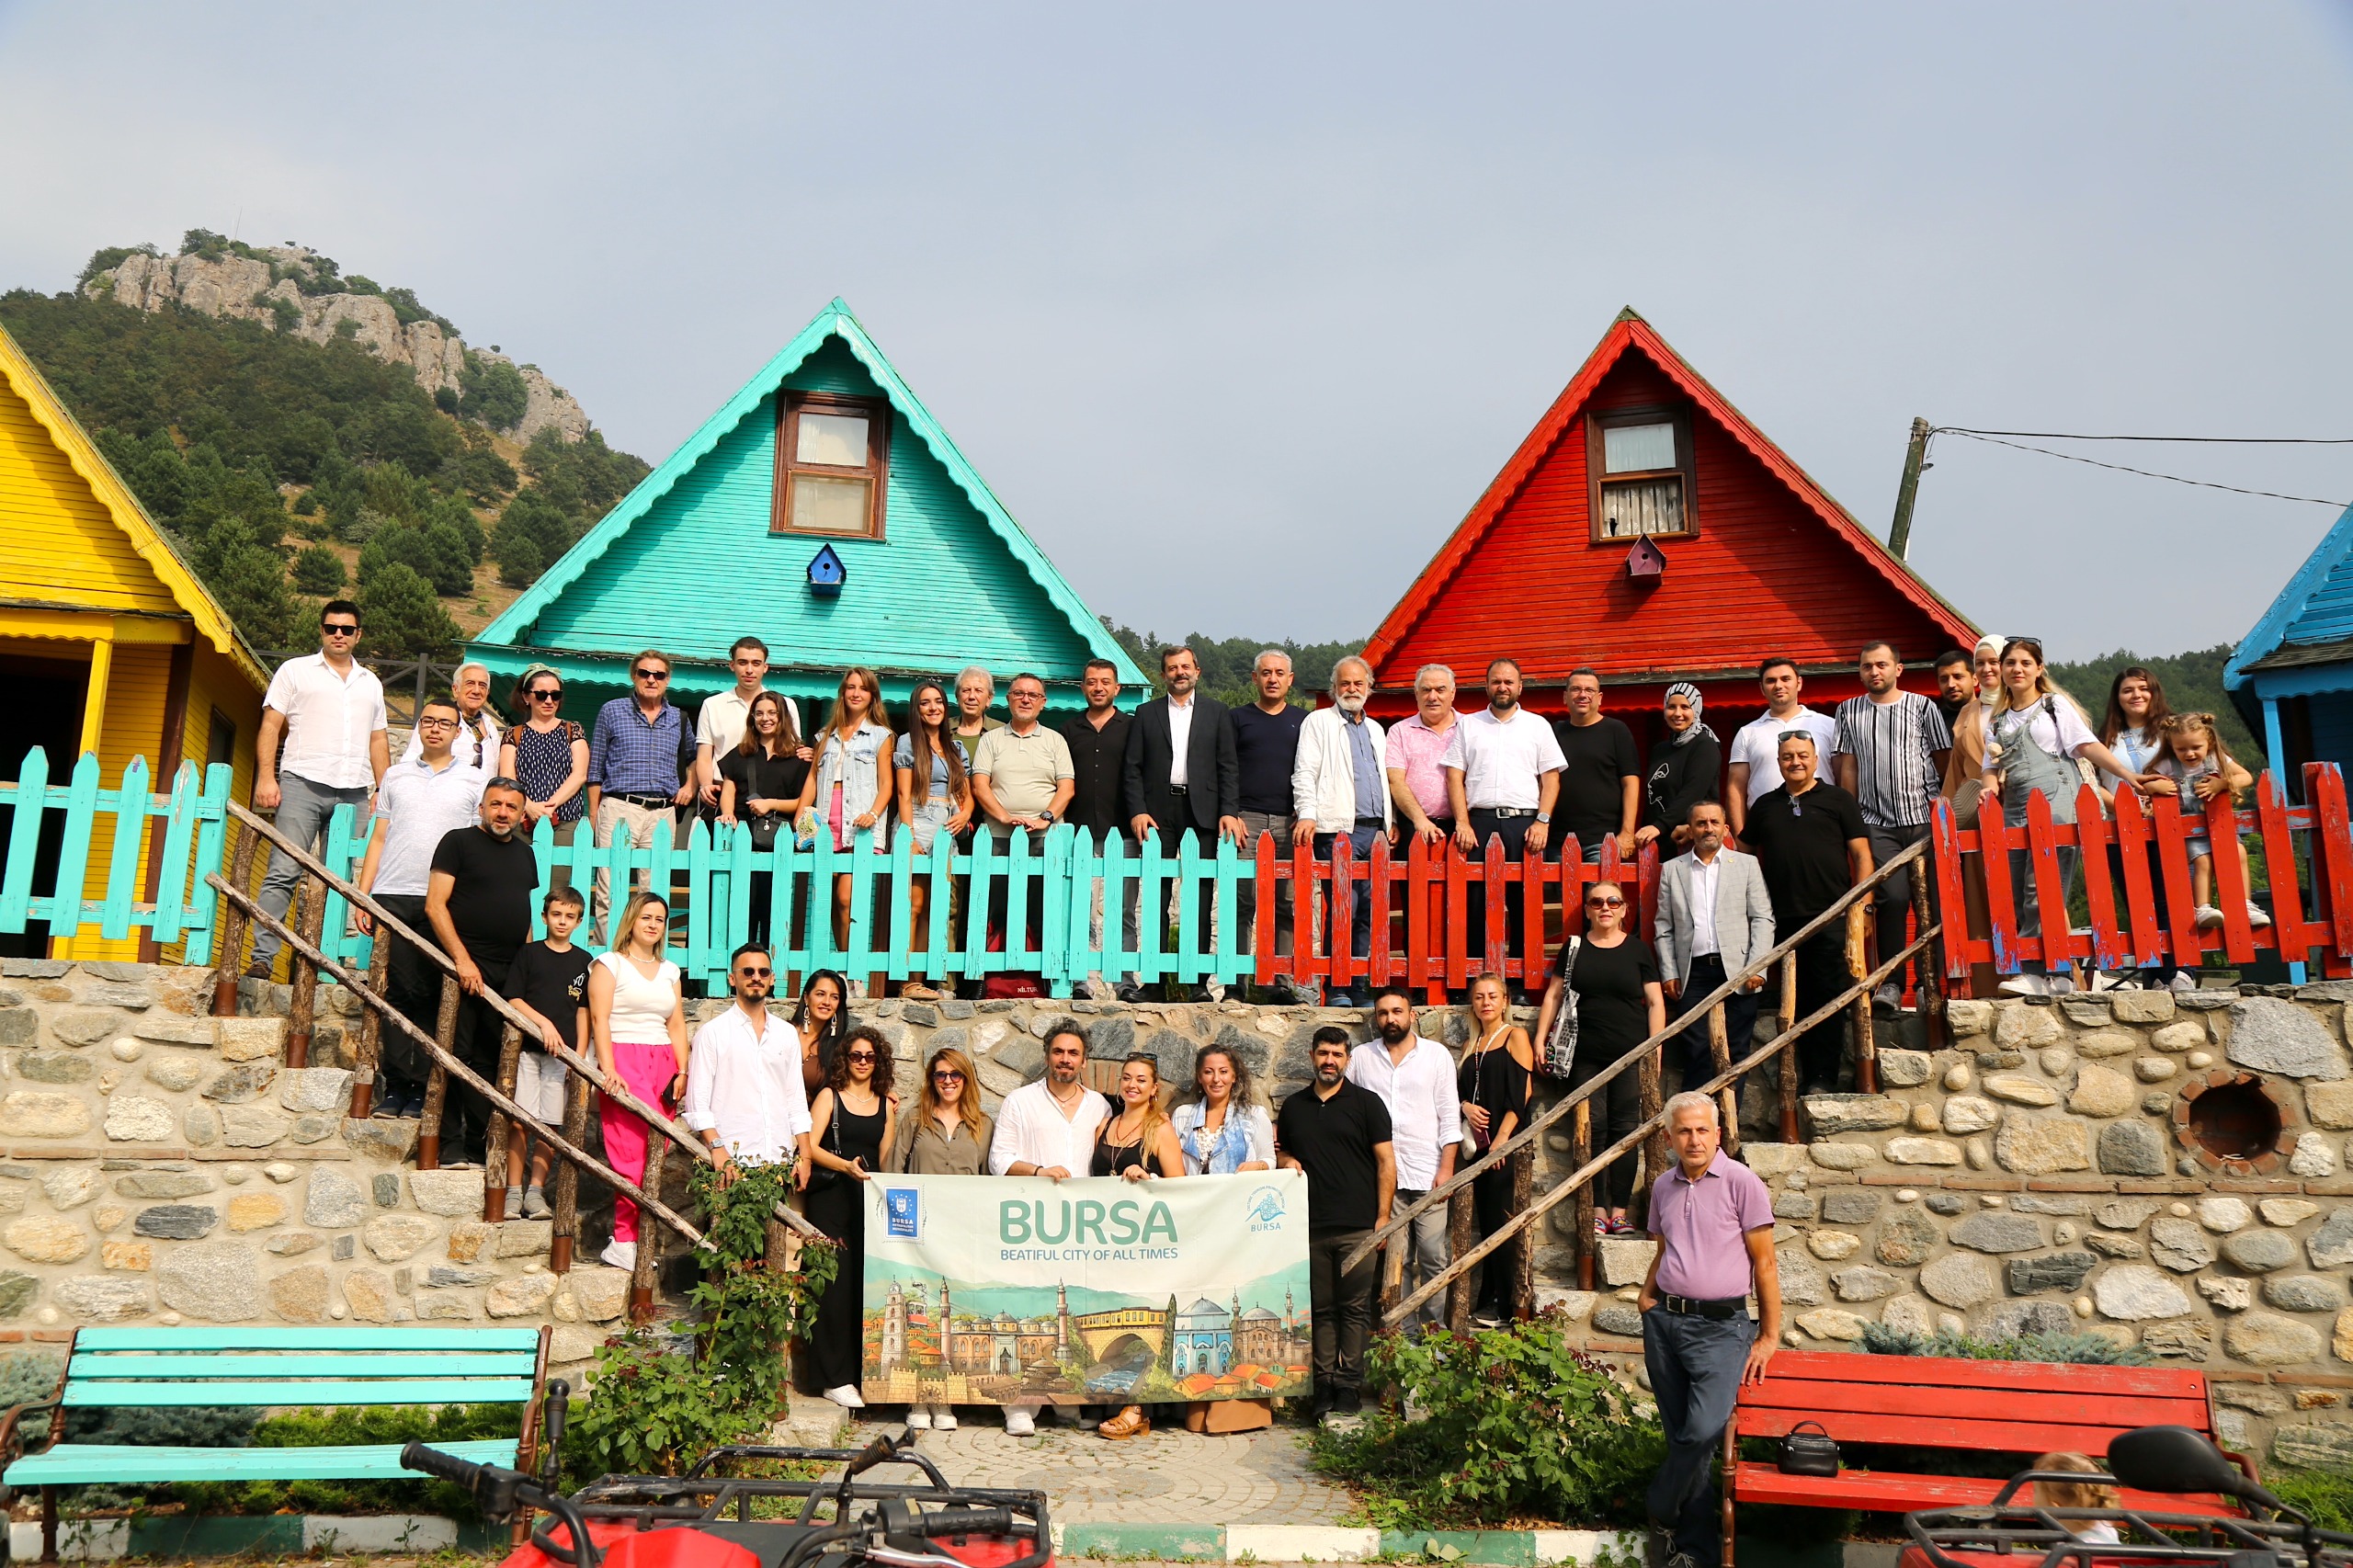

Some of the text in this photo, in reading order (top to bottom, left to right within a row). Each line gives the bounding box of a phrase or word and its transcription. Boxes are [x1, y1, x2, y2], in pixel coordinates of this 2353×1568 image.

[999, 1199, 1178, 1245] BURSA
[1251, 1222, 1281, 1232] BURSA
[1000, 1247, 1178, 1261] BEATIFUL CITY OF ALL TIMES
